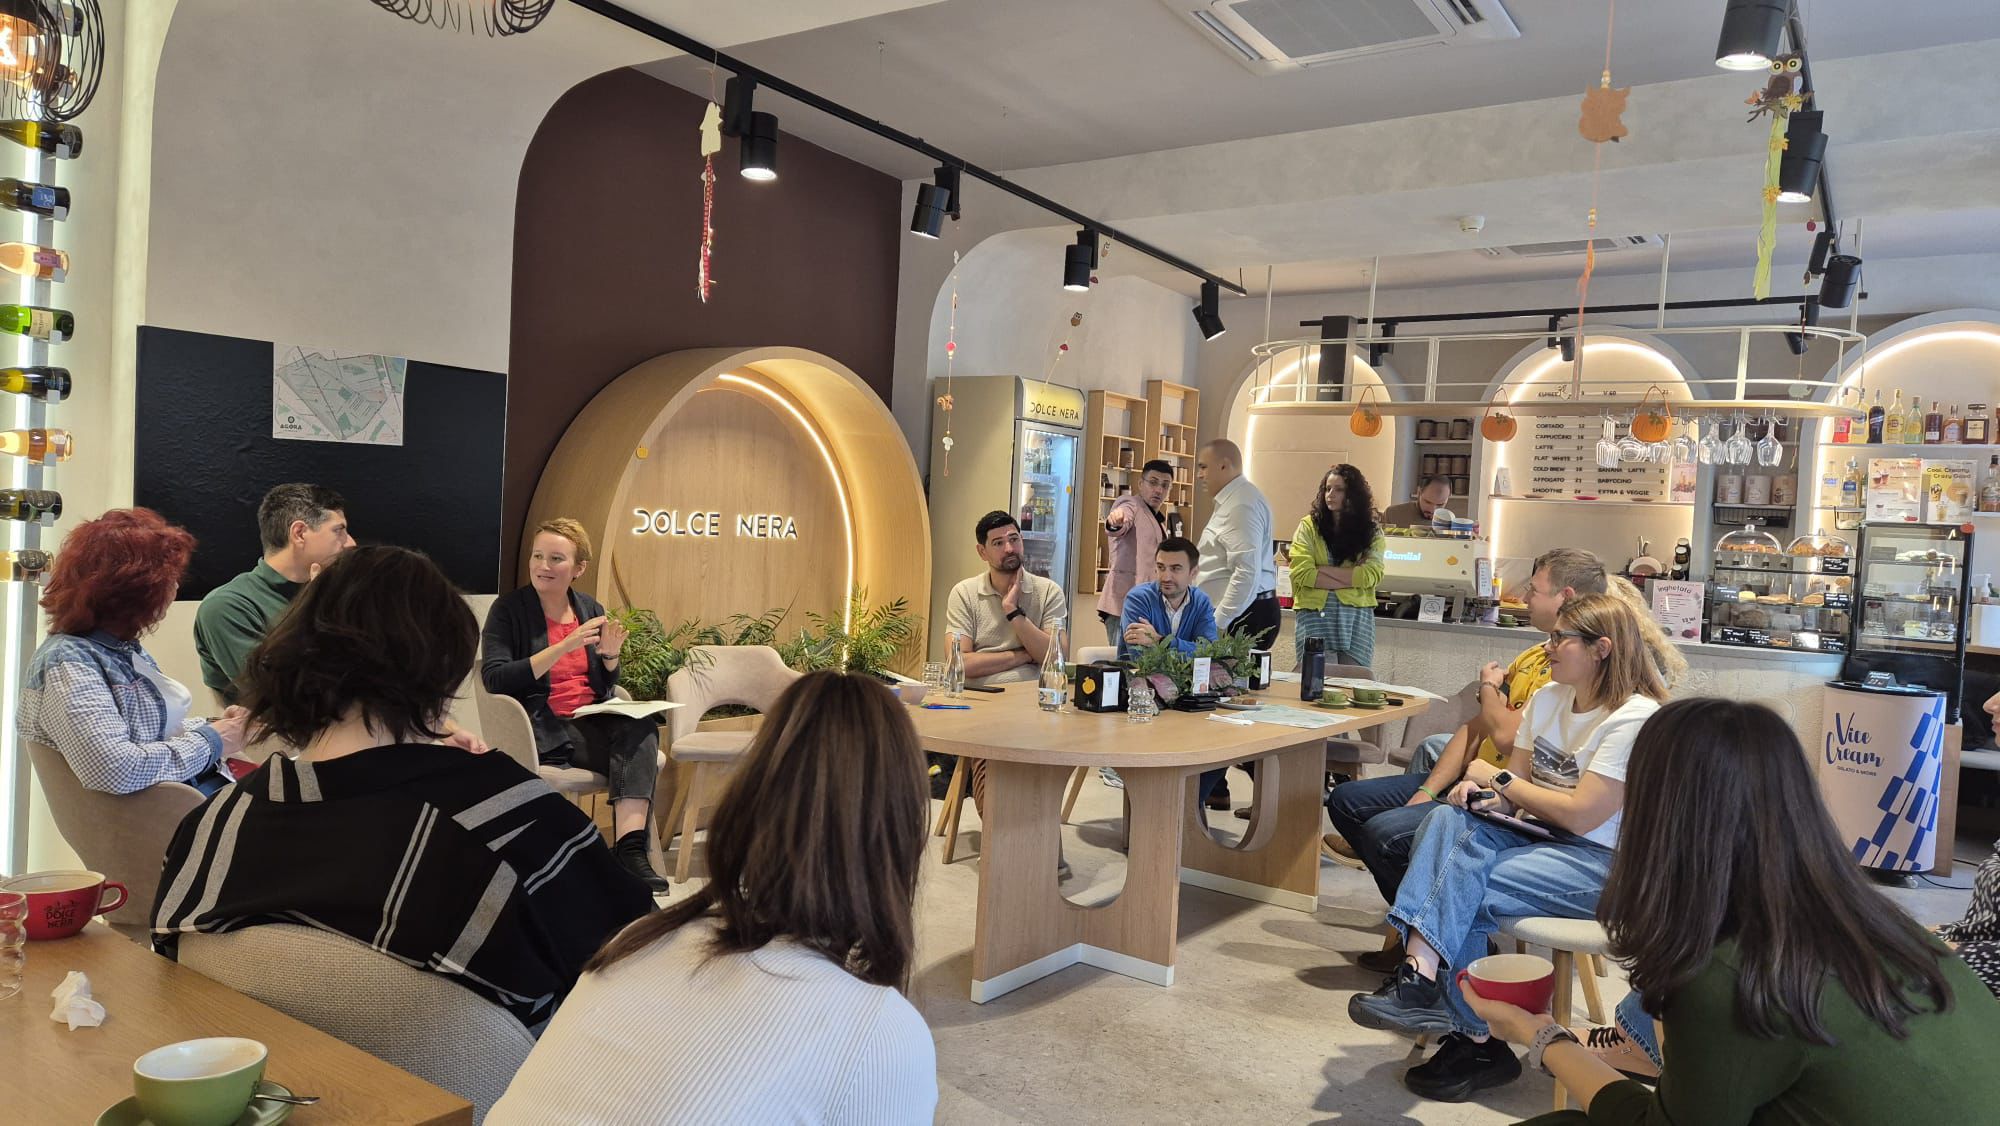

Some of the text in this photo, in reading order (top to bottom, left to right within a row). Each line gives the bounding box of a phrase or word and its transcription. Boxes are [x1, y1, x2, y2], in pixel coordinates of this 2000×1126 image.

[1030, 402, 1078, 420] DOLCE NERA
[632, 508, 798, 540] DOLCE NERA
[1836, 712, 1872, 746] Vice
[1826, 732, 1885, 768] Cream
[1837, 765, 1856, 773] GELATO
